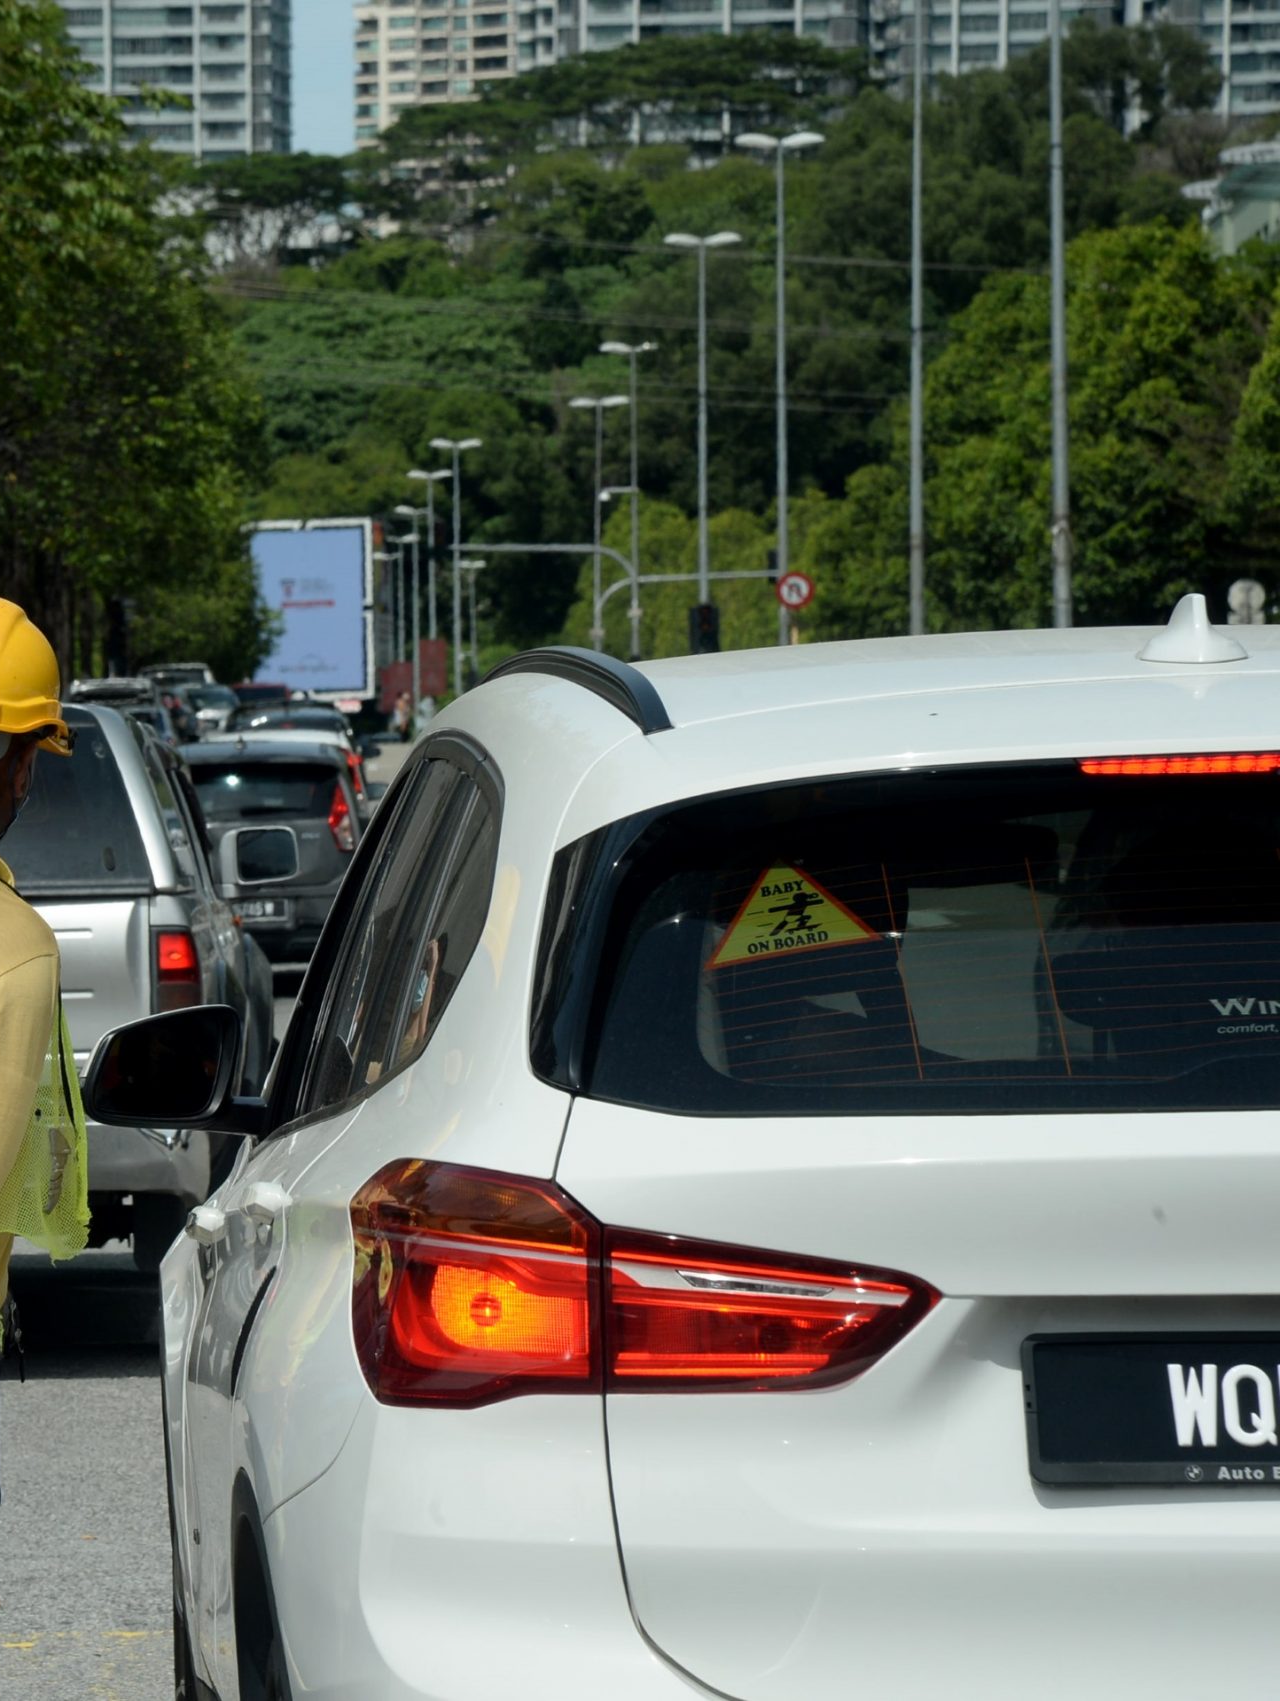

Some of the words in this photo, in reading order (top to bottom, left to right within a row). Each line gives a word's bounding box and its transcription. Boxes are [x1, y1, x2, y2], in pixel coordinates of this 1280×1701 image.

[760, 880, 805, 897] BABY
[747, 940, 770, 954] ON
[774, 930, 829, 950] BOARD
[1166, 1363, 1280, 1447] WQ
[1217, 1466, 1265, 1481] Auto
